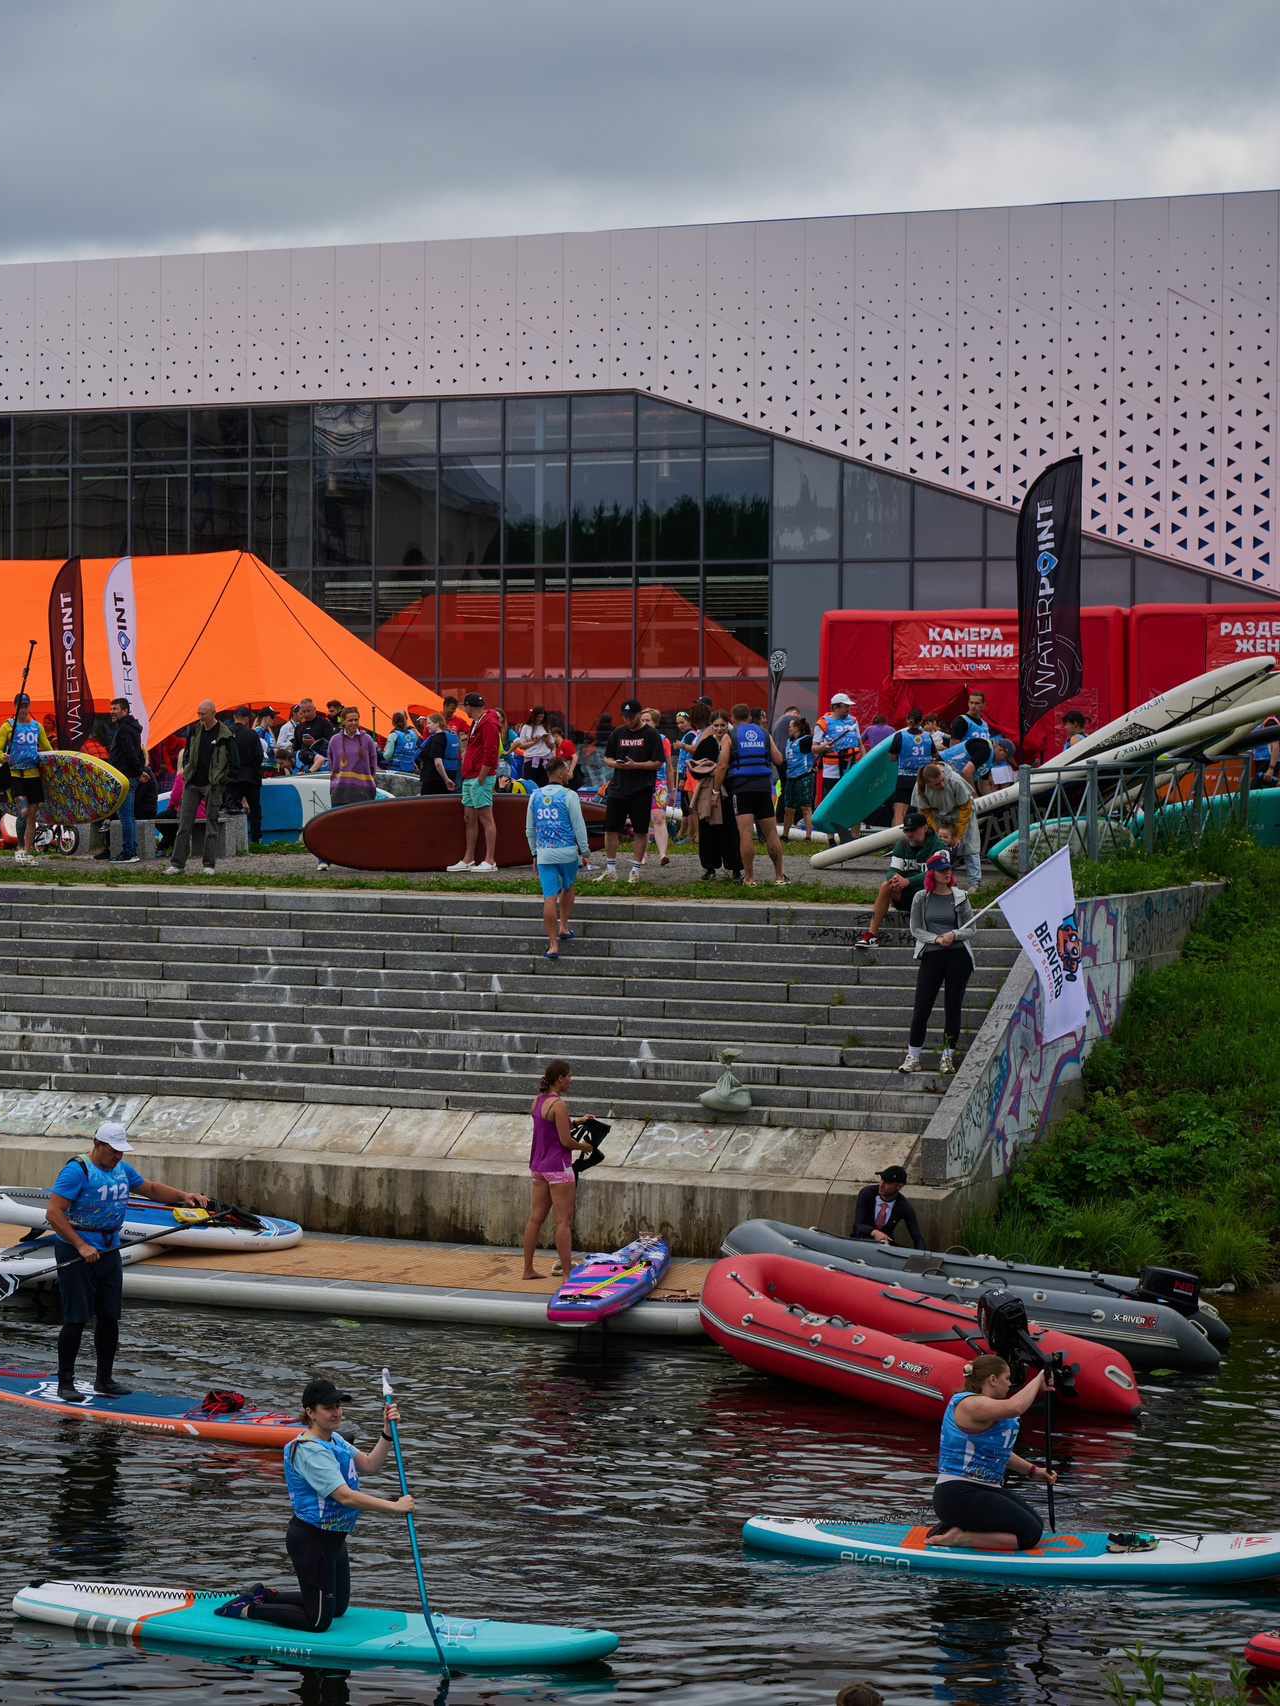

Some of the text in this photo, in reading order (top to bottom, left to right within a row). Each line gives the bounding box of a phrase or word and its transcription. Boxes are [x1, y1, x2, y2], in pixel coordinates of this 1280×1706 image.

[1034, 502, 1058, 696] WATERPOINT
[928, 627, 1004, 641] КАМЕРА
[918, 644, 1014, 658] ХРАНЕНИЯ
[60, 593, 83, 740] WATERPOINT
[943, 663, 992, 671] ВОДАТОЧКА
[404, 742, 415, 750] 47
[912, 747, 925, 756] 31
[1122, 739, 1158, 756] HEYtex
[537, 808, 559, 820] 303
[1034, 921, 1063, 999] BEAVERS
[1027, 933, 1055, 1004] SUP SCHOOL
[97, 1183, 129, 1201] 112
[1174, 1280, 1195, 1293] NS
[1113, 1313, 1146, 1325] X-RIVER
[897, 1360, 922, 1374] X-RIVER
